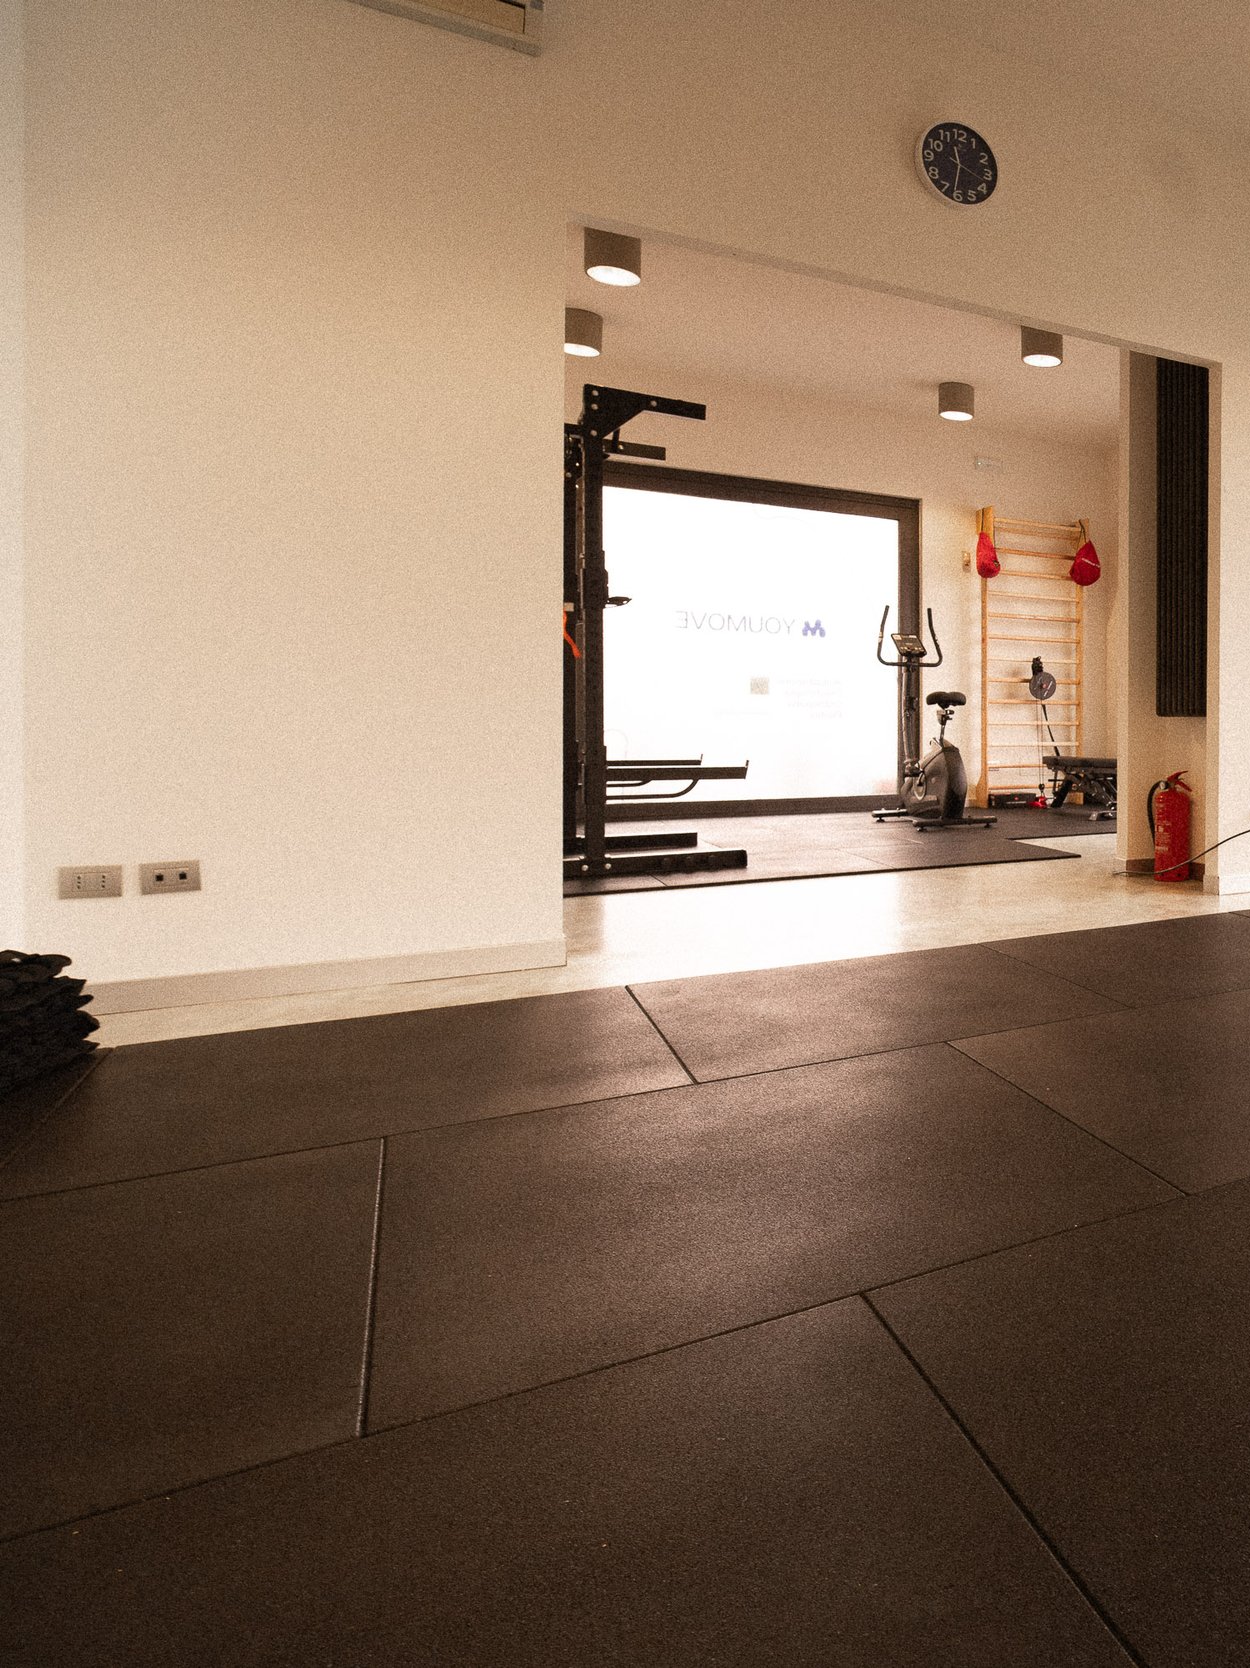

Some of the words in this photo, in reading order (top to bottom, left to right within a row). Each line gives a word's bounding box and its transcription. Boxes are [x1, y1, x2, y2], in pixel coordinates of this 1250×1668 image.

[938, 129, 950, 142] 11
[952, 128, 967, 143] 12
[928, 138, 943, 152] 10
[971, 138, 976, 149] 1
[924, 150, 934, 161] 9
[979, 152, 989, 165] 2
[928, 166, 939, 179] 8
[983, 168, 992, 181] 3
[940, 181, 949, 192] 7
[977, 183, 987, 195] 4
[953, 190, 963, 202] 6
[967, 190, 977, 201] 5
